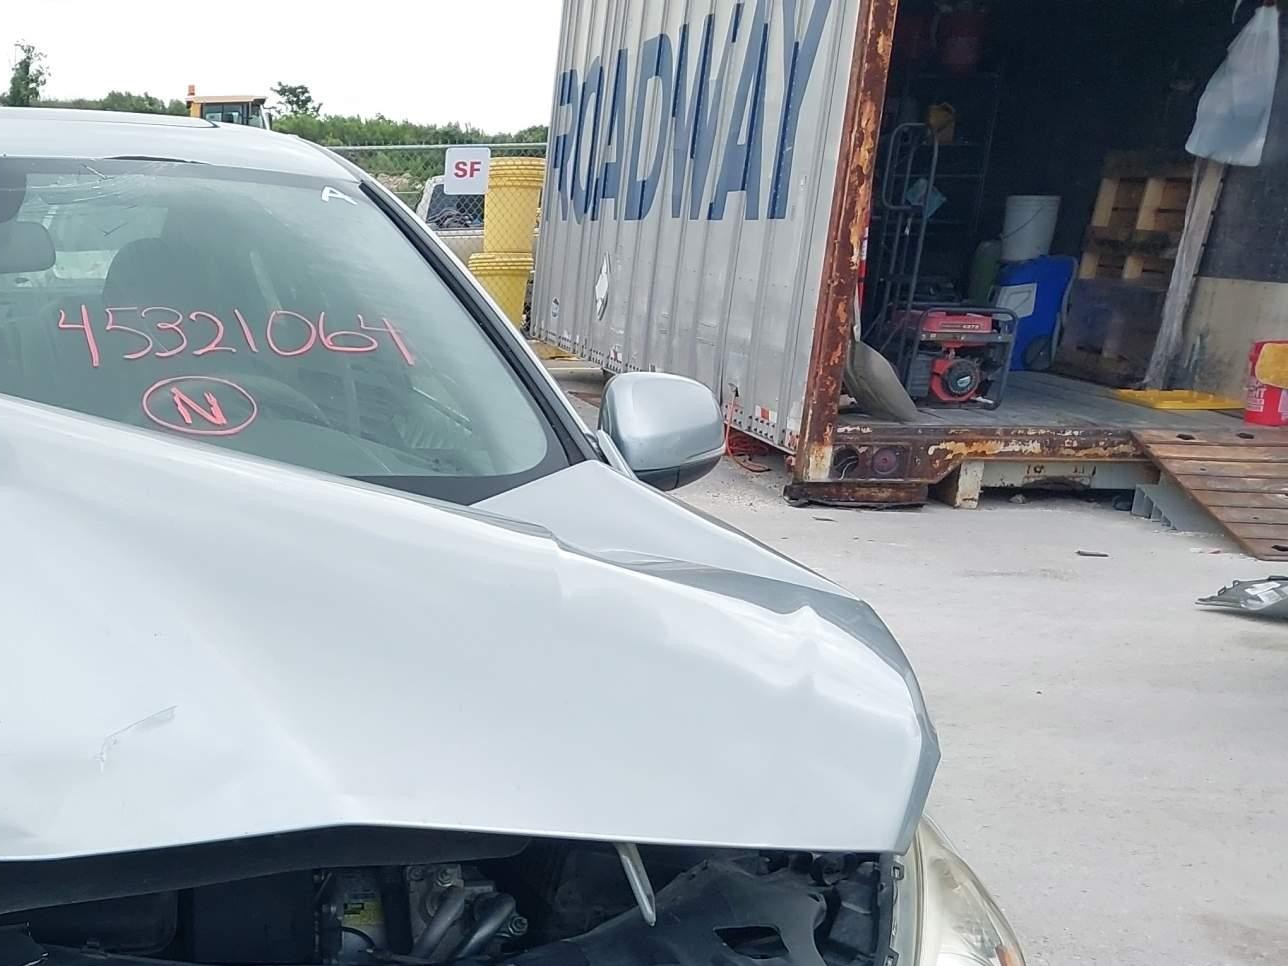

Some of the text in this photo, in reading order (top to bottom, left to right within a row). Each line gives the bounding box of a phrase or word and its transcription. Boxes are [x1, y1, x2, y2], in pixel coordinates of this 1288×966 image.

[545, 0, 832, 225] ROADWAY
[453, 160, 482, 179] SF
[57, 303, 416, 367] 45321064
[169, 386, 228, 426] N
